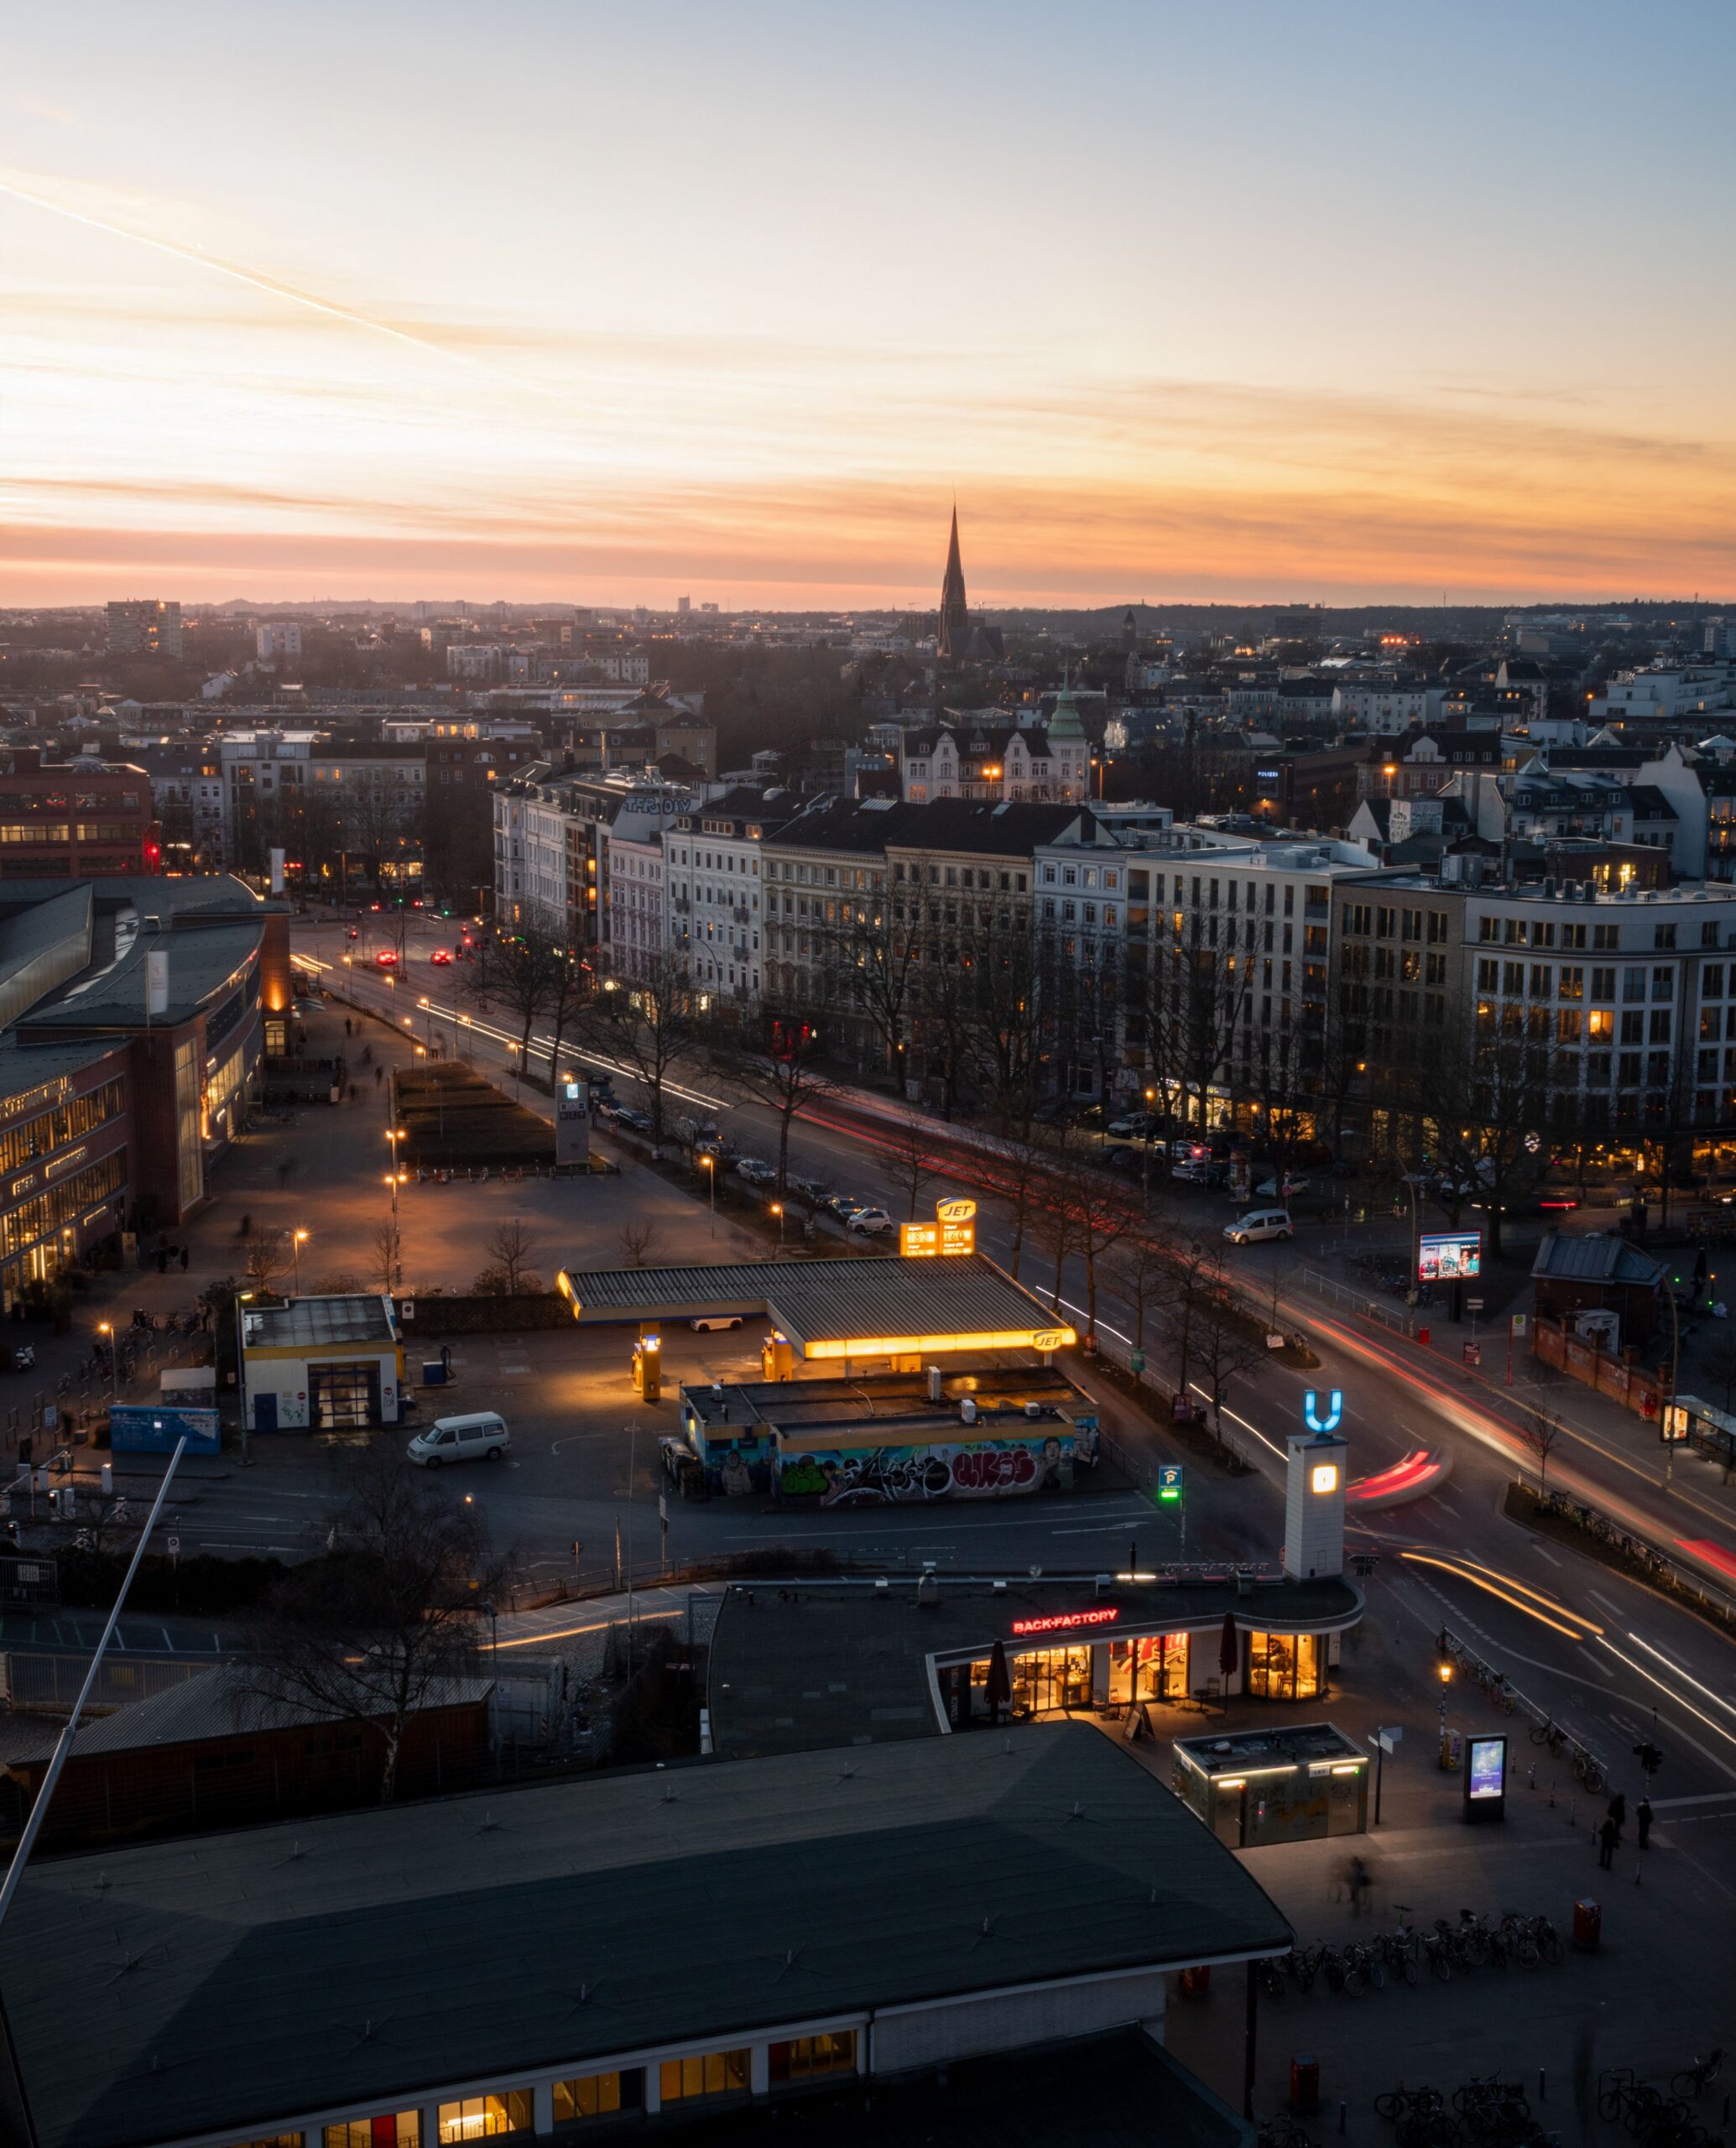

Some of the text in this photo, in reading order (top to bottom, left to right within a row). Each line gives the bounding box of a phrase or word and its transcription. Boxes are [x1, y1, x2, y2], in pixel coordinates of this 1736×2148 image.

[945, 1206, 971, 1217] JET
[1038, 1337, 1061, 1346] JET
[1305, 1389, 1342, 1433] U
